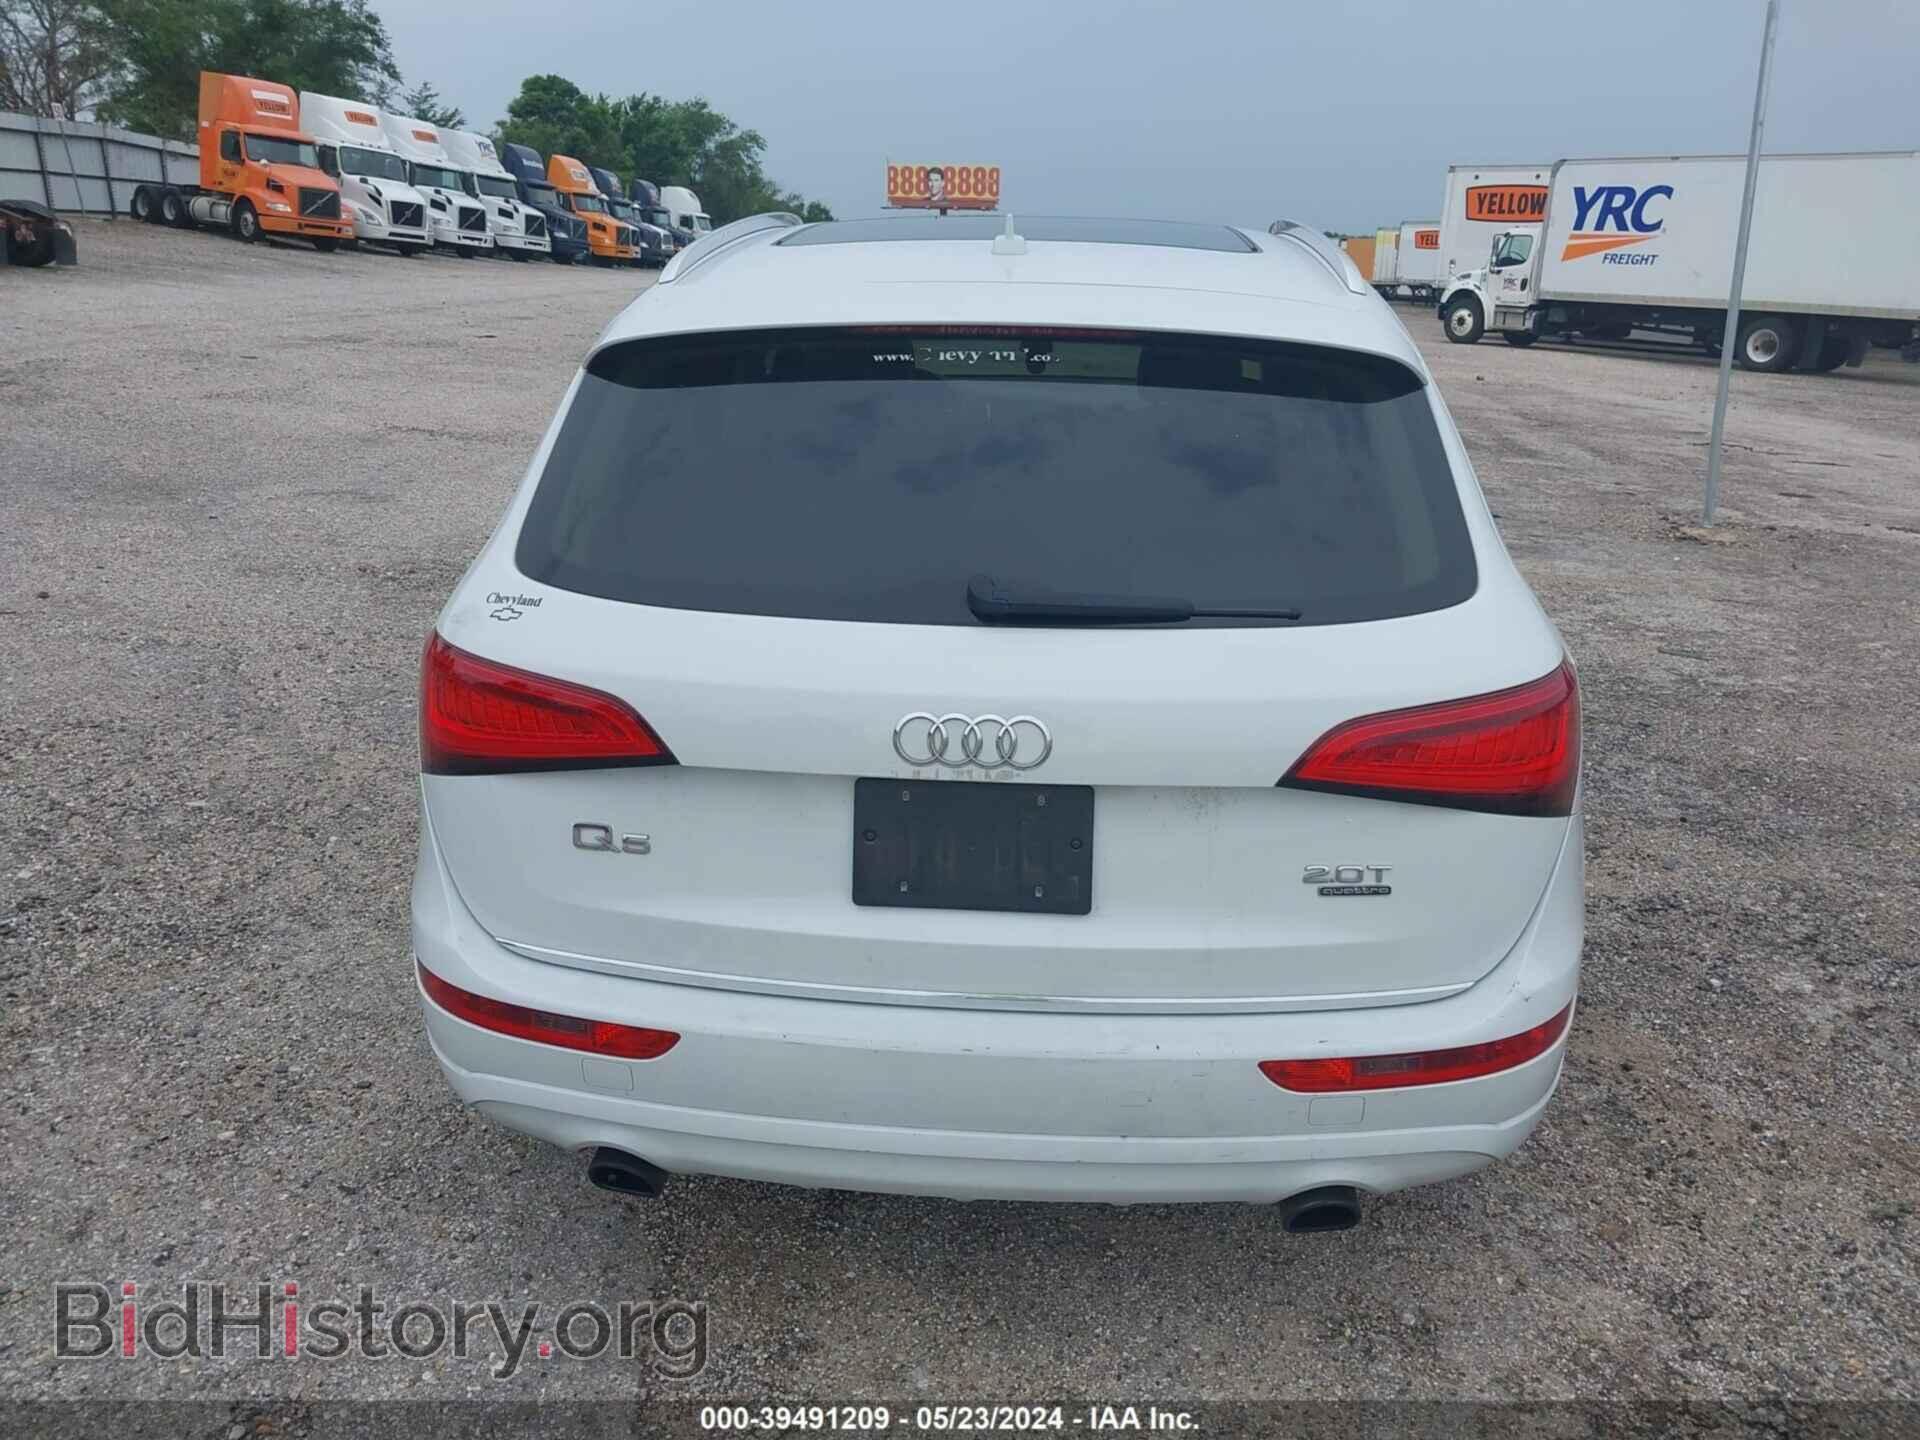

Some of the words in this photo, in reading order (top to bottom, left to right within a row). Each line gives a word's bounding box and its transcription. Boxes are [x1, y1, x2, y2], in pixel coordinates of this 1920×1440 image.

[1476, 192, 1548, 215] YELLOW
[1571, 184, 1674, 233] YRC
[1601, 252, 1660, 266] FREIGHT
[572, 822, 651, 856] Q5
[1302, 864, 1393, 884] 2.0T
[1320, 886, 1391, 896] quattro
